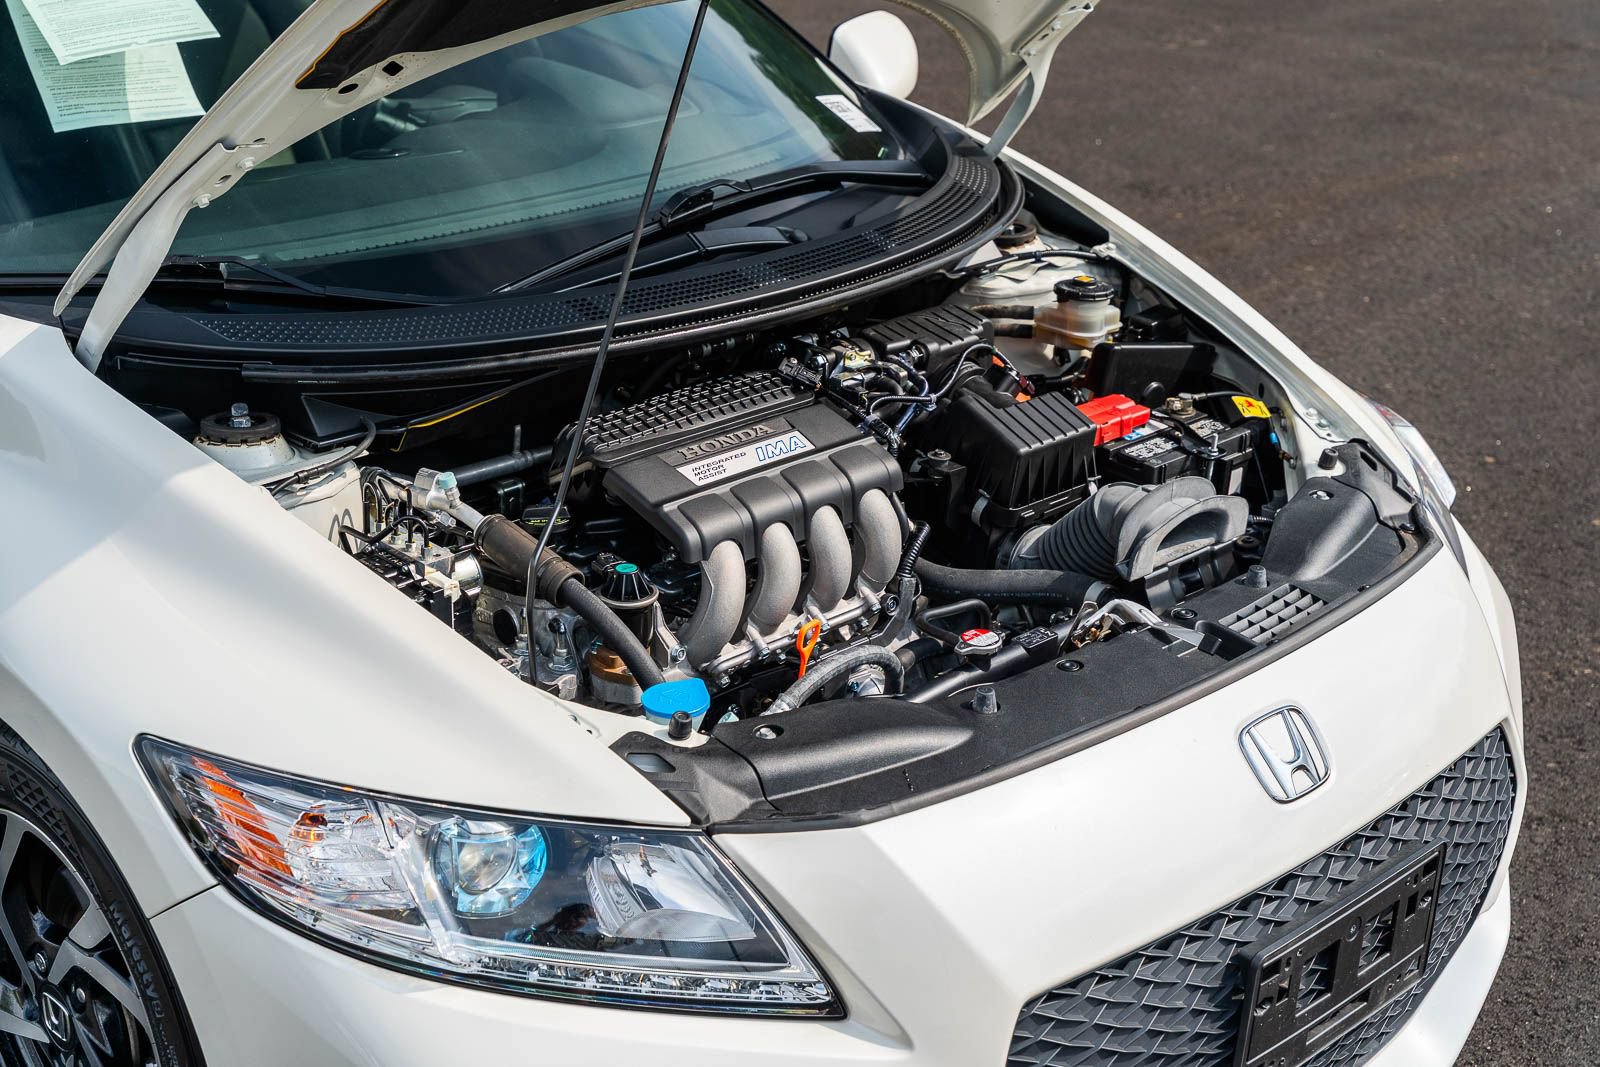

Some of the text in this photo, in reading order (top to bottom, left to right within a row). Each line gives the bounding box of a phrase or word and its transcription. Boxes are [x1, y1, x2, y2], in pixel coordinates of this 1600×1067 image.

[677, 424, 777, 460] HONDA
[755, 435, 807, 462] IMA
[692, 451, 747, 472] INTEGRATED
[694, 464, 725, 477] MOTOR
[698, 469, 727, 481] ASSIST
